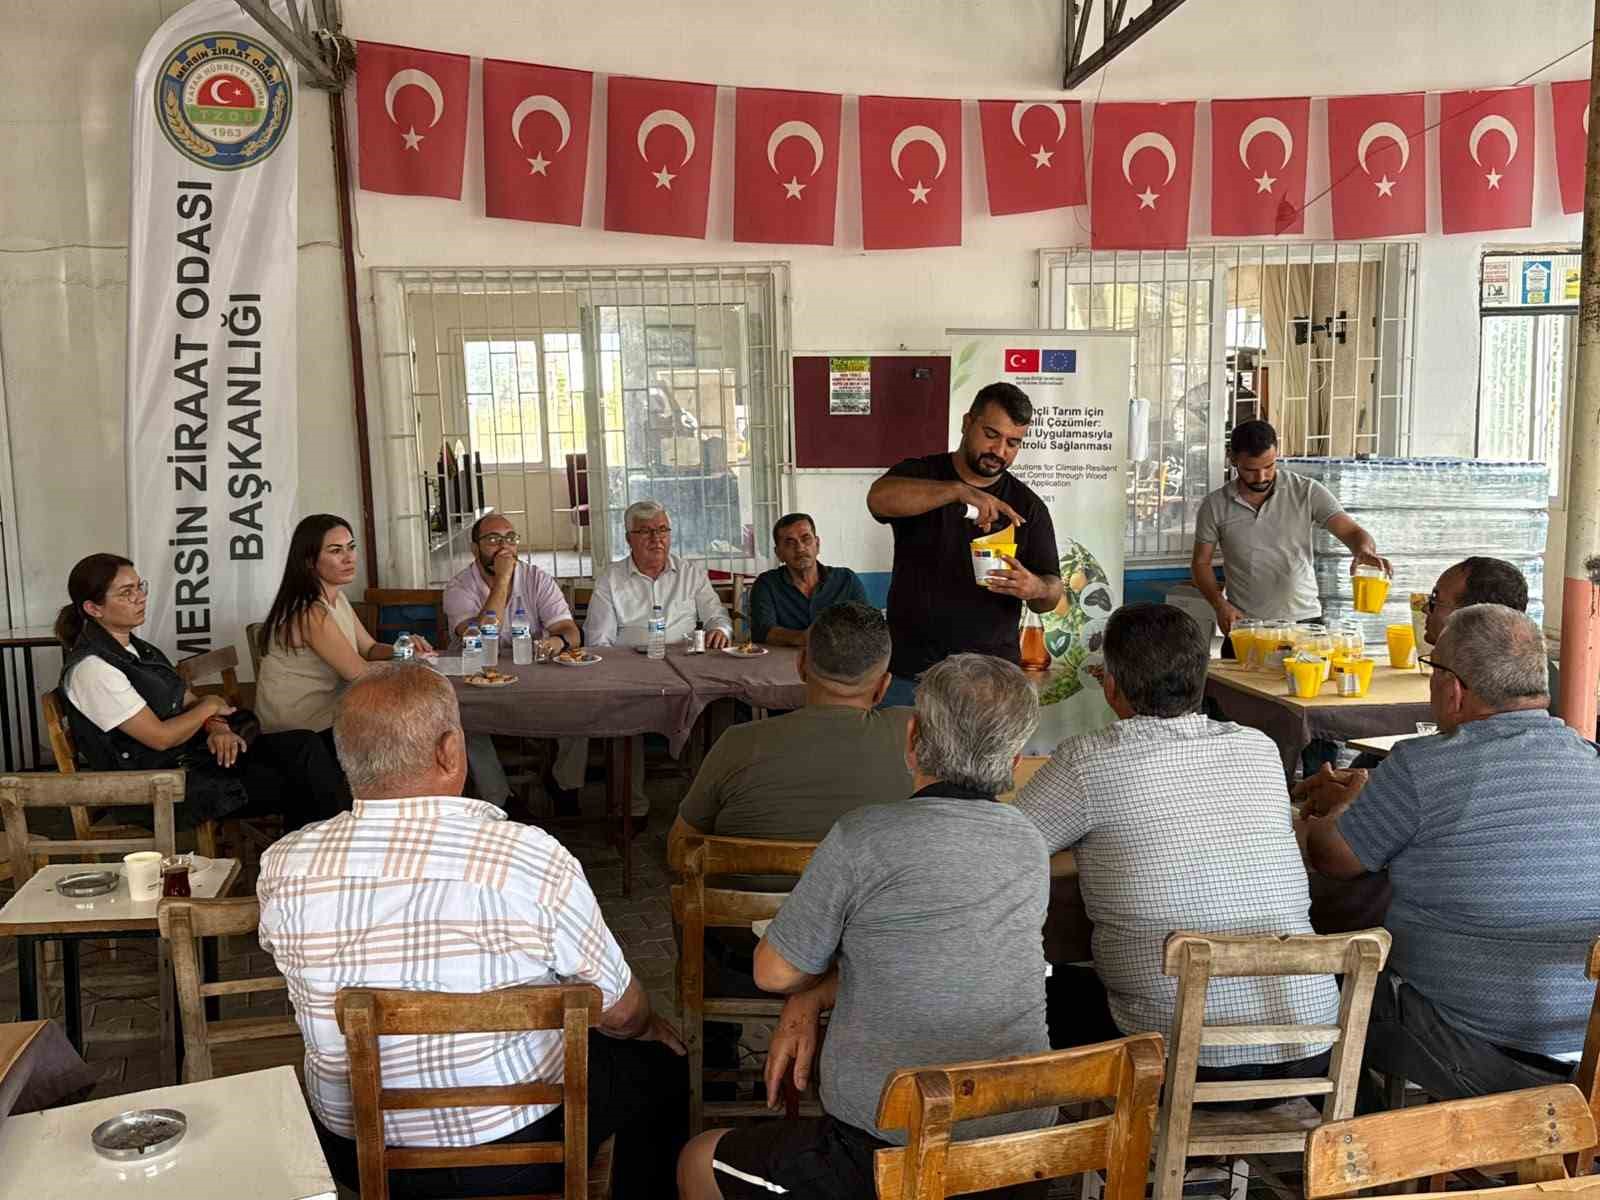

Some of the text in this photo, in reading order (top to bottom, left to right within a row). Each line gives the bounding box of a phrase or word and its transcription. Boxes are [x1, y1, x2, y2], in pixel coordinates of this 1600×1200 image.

[176, 46, 276, 84] MERSİN ZİRAAT ODASI
[1031, 406, 1104, 418] nçli Tarım için
[167, 181, 212, 663] MERSİN ZİRAAT ODASI
[220, 294, 272, 560] BAŞKANLIĞI
[1029, 417, 1102, 428] elli Çözümler:
[1035, 428, 1113, 441] Uygulamasıyla
[1019, 440, 1112, 452] trolü Sağlanması
